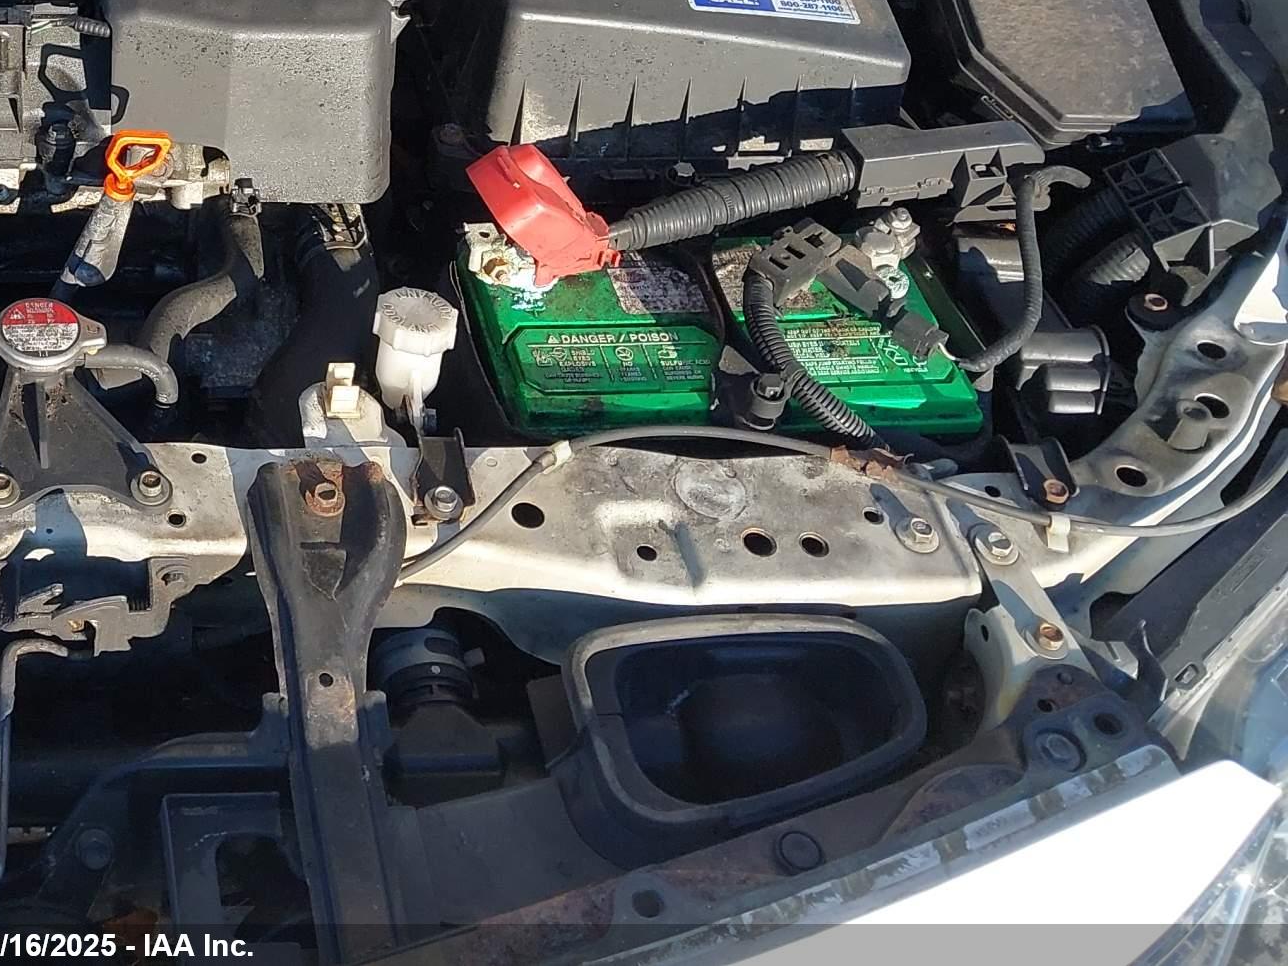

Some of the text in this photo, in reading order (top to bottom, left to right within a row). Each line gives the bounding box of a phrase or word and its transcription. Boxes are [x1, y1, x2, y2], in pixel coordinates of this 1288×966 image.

[562, 332, 679, 344] DANGER / POISON
